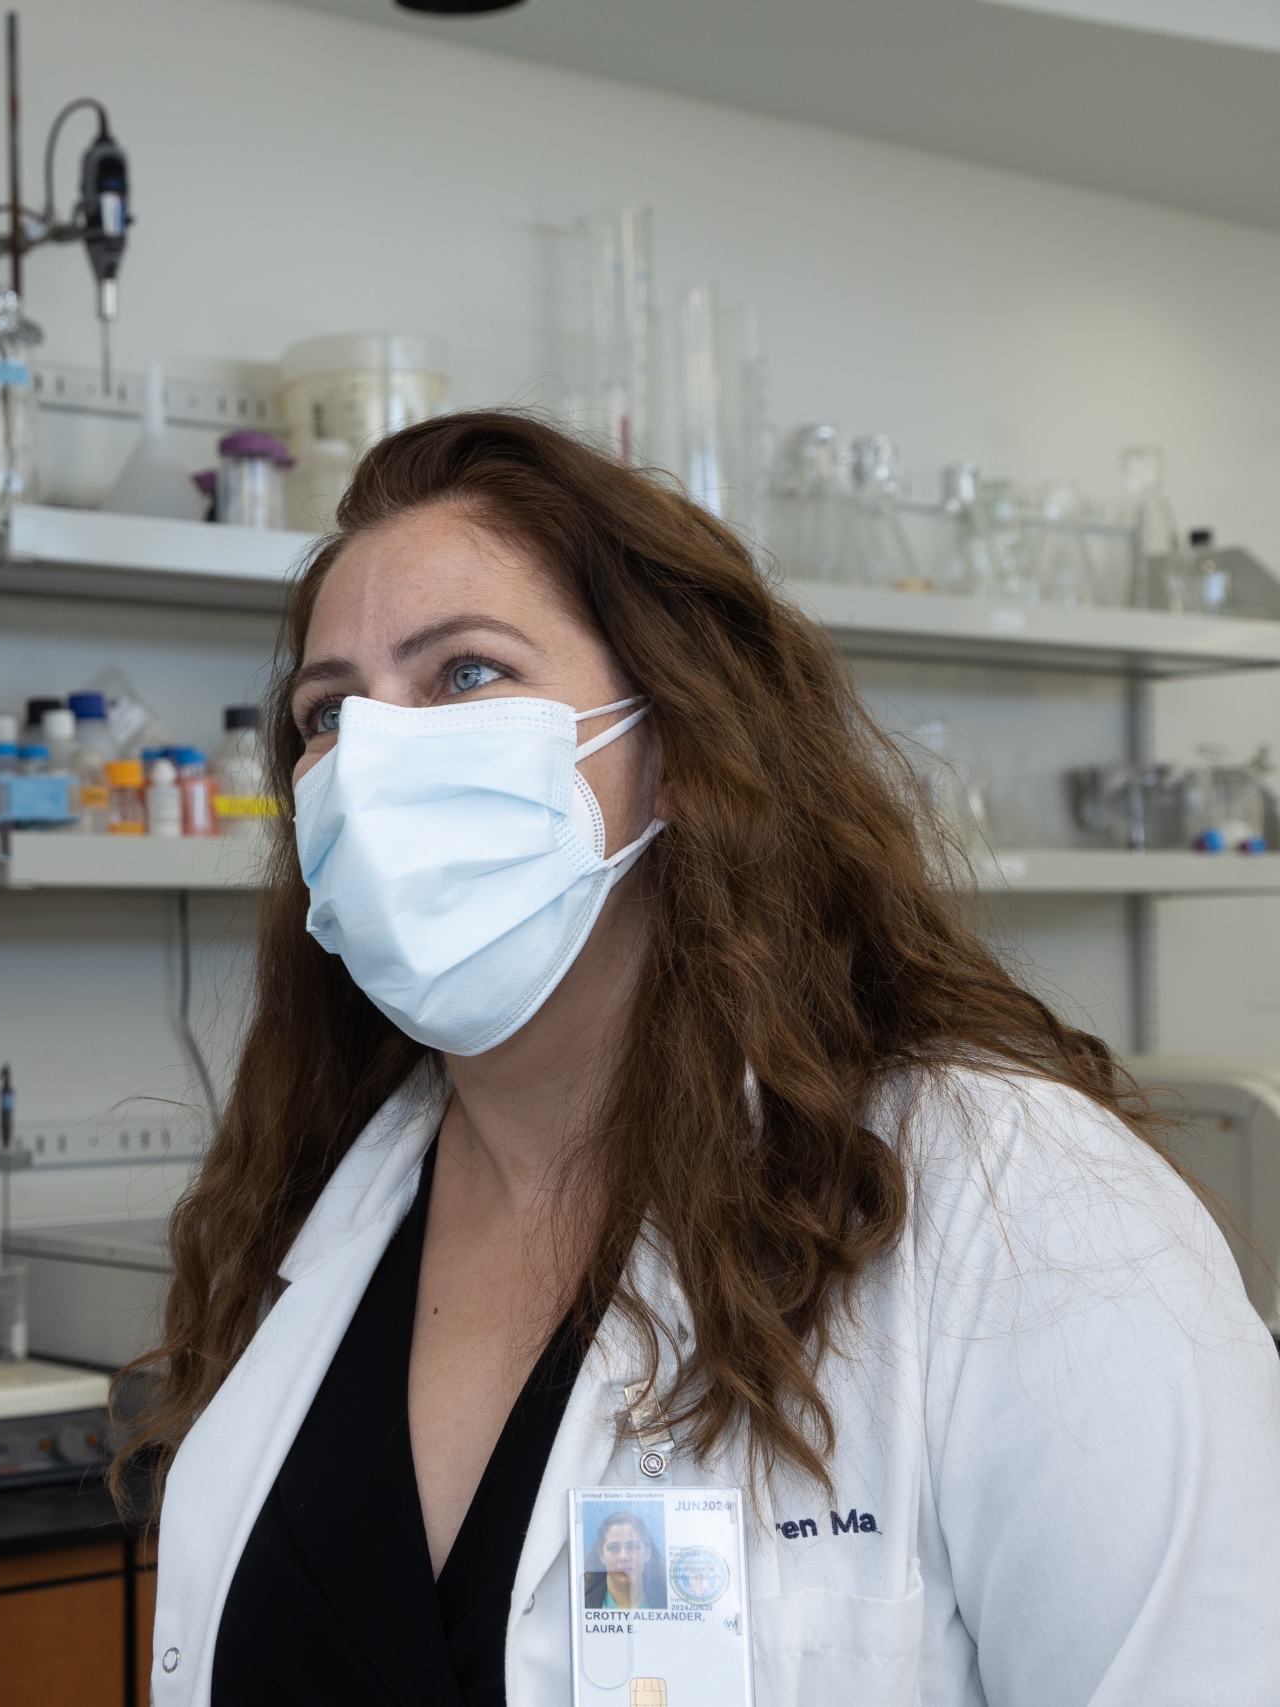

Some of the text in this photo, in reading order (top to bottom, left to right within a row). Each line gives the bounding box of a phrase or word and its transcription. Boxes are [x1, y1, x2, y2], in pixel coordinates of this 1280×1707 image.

[674, 1500, 732, 1512] JUN2024
[829, 1508, 877, 1536] Ma
[671, 1604, 713, 1612] 2024JUN30
[585, 1611, 706, 1623] CROTTY ALEXANDER,
[585, 1624, 637, 1634] LAURA E.
